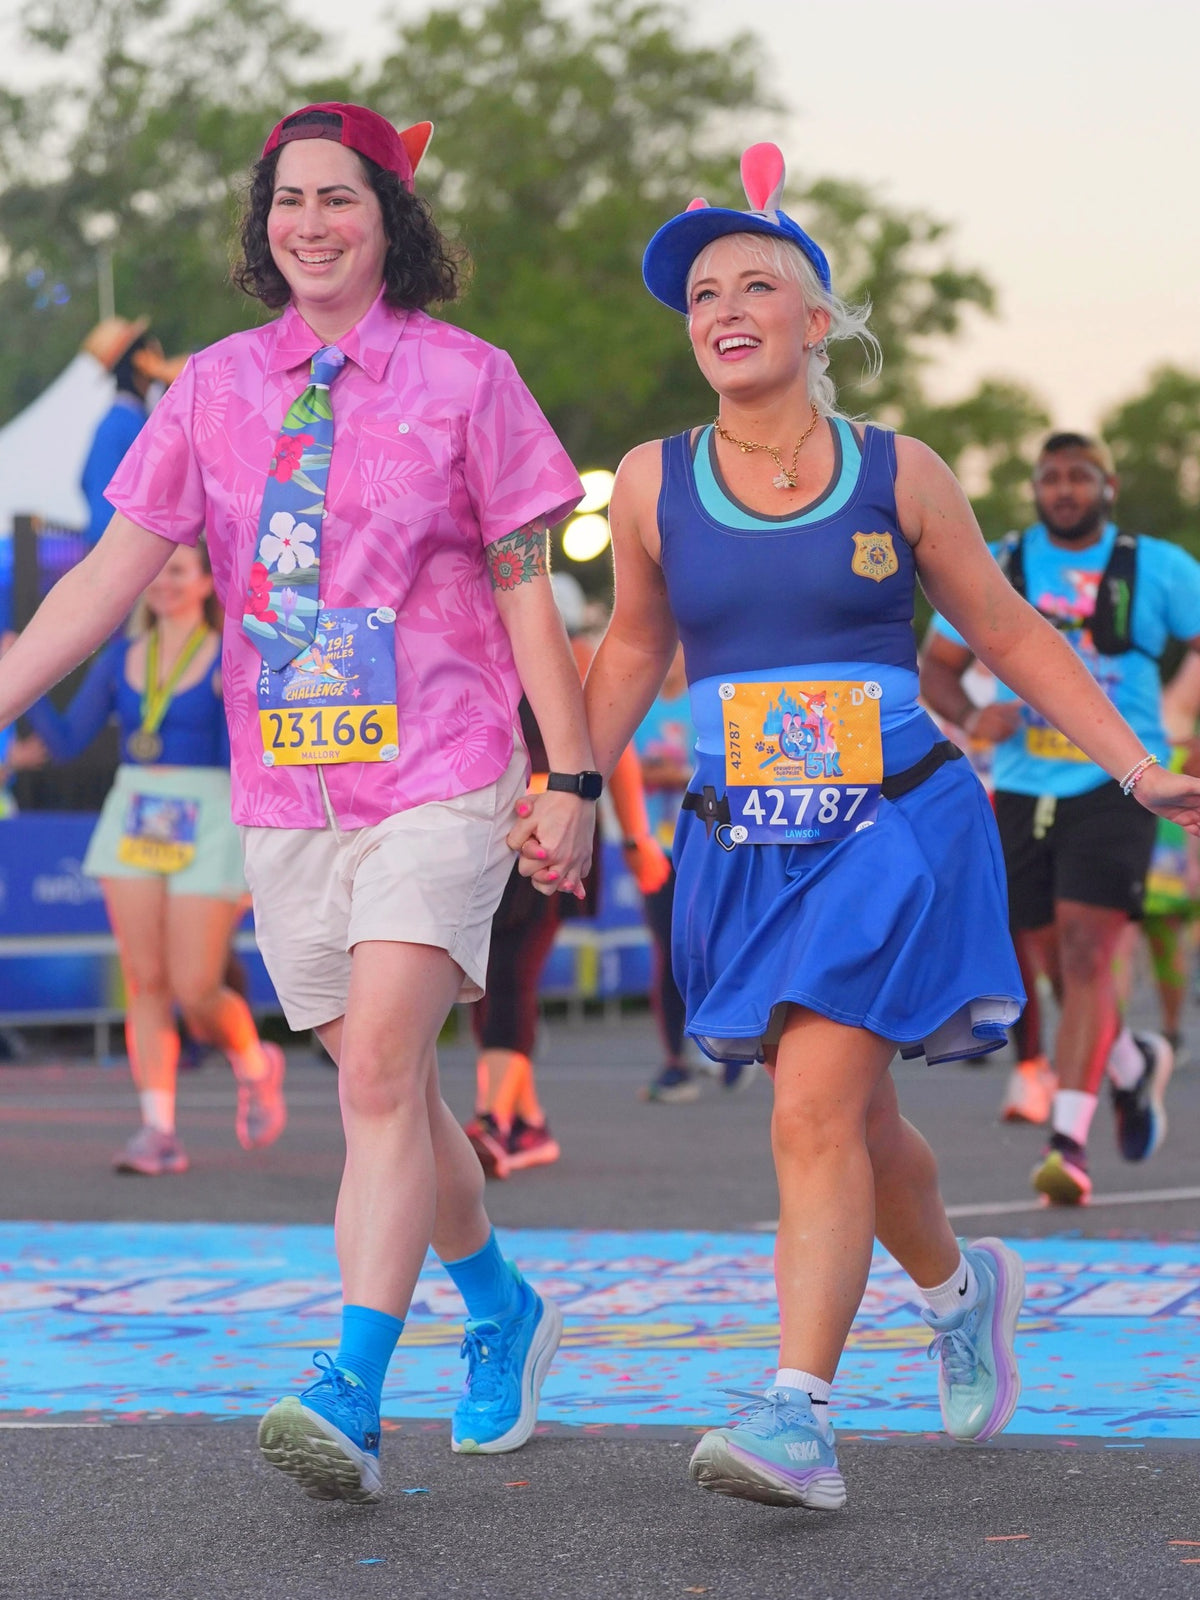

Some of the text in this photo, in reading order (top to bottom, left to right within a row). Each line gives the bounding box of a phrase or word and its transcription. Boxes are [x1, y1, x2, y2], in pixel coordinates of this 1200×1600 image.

[326, 634, 354, 652] 19.3
[325, 648, 354, 661] MILES
[285, 682, 347, 701] CHALLENGE
[851, 687, 865, 706] D
[269, 709, 383, 748] 23166
[301, 750, 341, 760] MALLORY
[729, 721, 742, 770] 42787
[804, 752, 844, 778] 5K
[742, 787, 869, 826] 42787
[785, 828, 820, 839] LAWSON
[784, 1440, 820, 1461] HOKA
